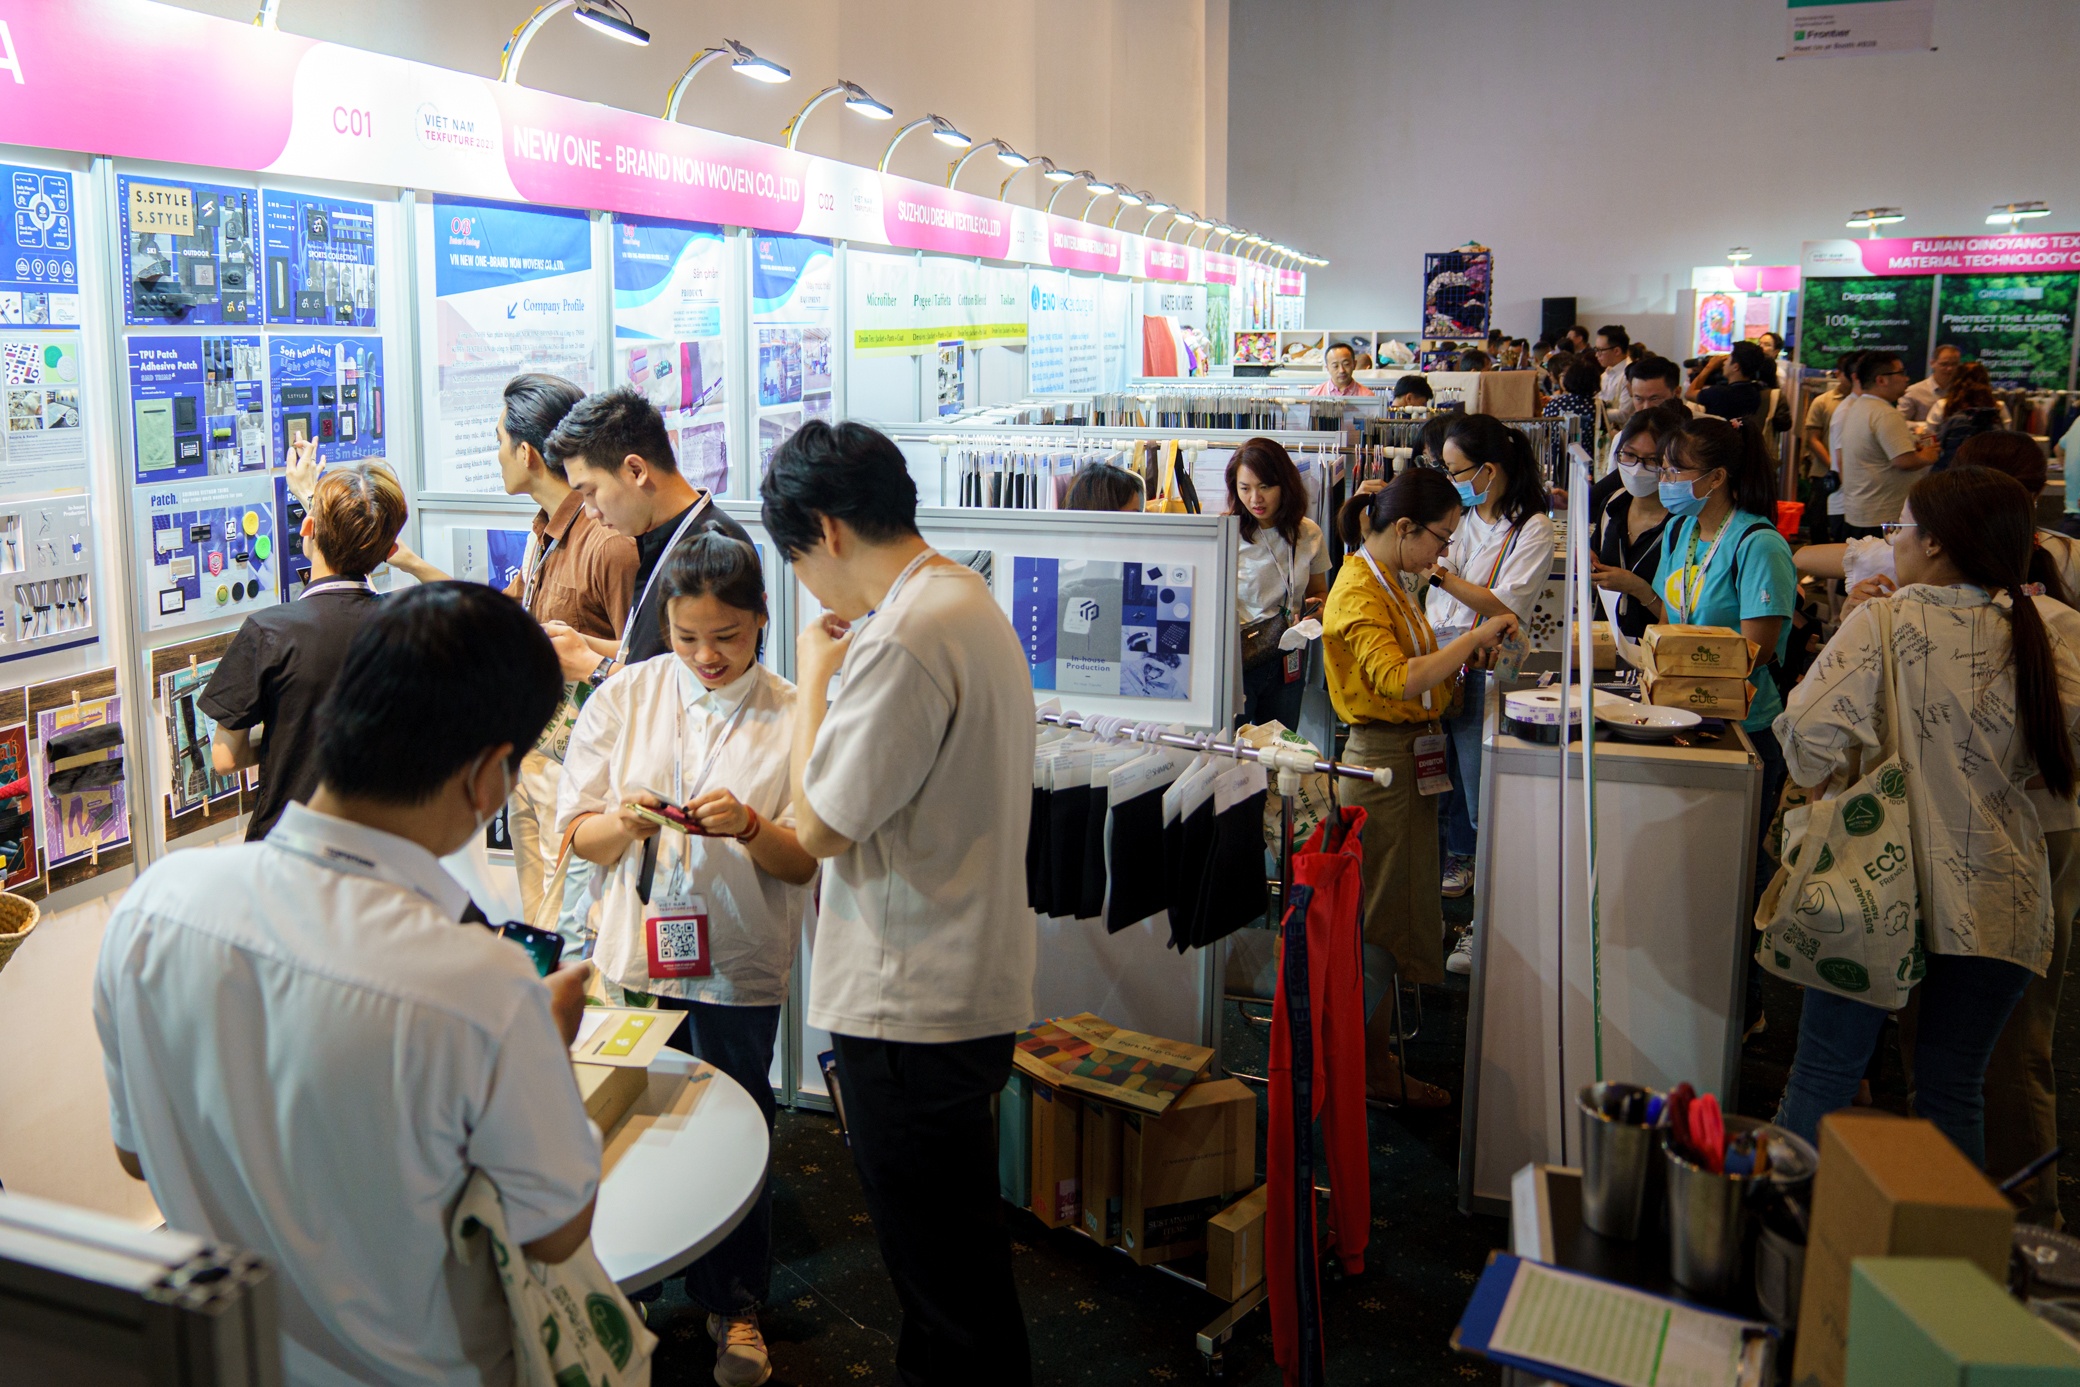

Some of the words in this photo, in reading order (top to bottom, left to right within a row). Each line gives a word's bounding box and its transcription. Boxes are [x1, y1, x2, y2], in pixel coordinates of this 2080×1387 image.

[333, 106, 371, 138] C01
[452, 119, 475, 133] NAM
[425, 130, 474, 147] TEXFUTURE
[513, 125, 560, 164] NEW
[563, 135, 602, 170] ONE
[615, 144, 671, 181] BRAND
[672, 158, 705, 187] NON
[706, 162, 754, 194] WOVEN
[136, 191, 187, 207] S.STYLE
[818, 192, 835, 211] C02
[137, 211, 188, 226] S.STYLE
[897, 200, 930, 224] SUZHOU
[930, 207, 954, 228] DREAM
[953, 212, 979, 233] TEXTILE
[1912, 240, 1964, 253] FUJIAN
[1966, 236, 2049, 251] QINGYANG
[183, 249, 210, 258] OUTDOOR
[308, 250, 327, 259] SPORTS
[328, 251, 358, 262] COLLECTION
[1888, 255, 1962, 269] MATERIAL
[1963, 253, 2071, 268] TECHNOLOGY
[459, 255, 473, 267] NEW
[474, 255, 509, 269] ONE-BRAND
[509, 258, 523, 270] NON
[522, 258, 545, 270] WOVENS
[866, 292, 898, 307] Microfiber
[957, 293, 974, 306] Cotton
[974, 293, 987, 306] Blend
[1000, 294, 1016, 305] Taslan
[1042, 293, 1056, 311] ENO
[1842, 291, 1897, 303] Degradable
[523, 298, 561, 315] Company
[562, 298, 585, 312] Profile
[1825, 314, 1857, 326] 100%
[1942, 314, 1998, 324] PROTECT
[1999, 314, 2023, 323] THE
[1850, 327, 1860, 339] 5
[1950, 324, 1970, 333] WE
[1971, 324, 1996, 333] ACT
[1998, 323, 2064, 333] TOGETHER
[139, 350, 155, 360] TPU
[156, 349, 178, 359] Patch
[280, 345, 297, 359] Soft
[297, 345, 316, 359] hand
[317, 344, 331, 358] feel
[140, 362, 176, 371] Adhesive
[177, 361, 198, 370] Patch
[1032, 576, 1039, 593] PU
[1071, 654, 1106, 664] In-house
[1690, 652, 1721, 663] cute
[1066, 662, 1111, 672] Production
[1689, 694, 1719, 705] cute
[1418, 757, 1444, 769] EXHIBITOR
[1879, 862, 1909, 888] FRIENDLY
[1849, 878, 1875, 935] SUSTAINABLE
[1865, 889, 1880, 920] FASHION
[1118, 1040, 1140, 1052] Park
[1143, 1045, 1163, 1056] Map
[1164, 1049, 1193, 1062] Guide
[1147, 1213, 1202, 1230] SUSTAINABLE
[1163, 1225, 1188, 1237] ITEMS
